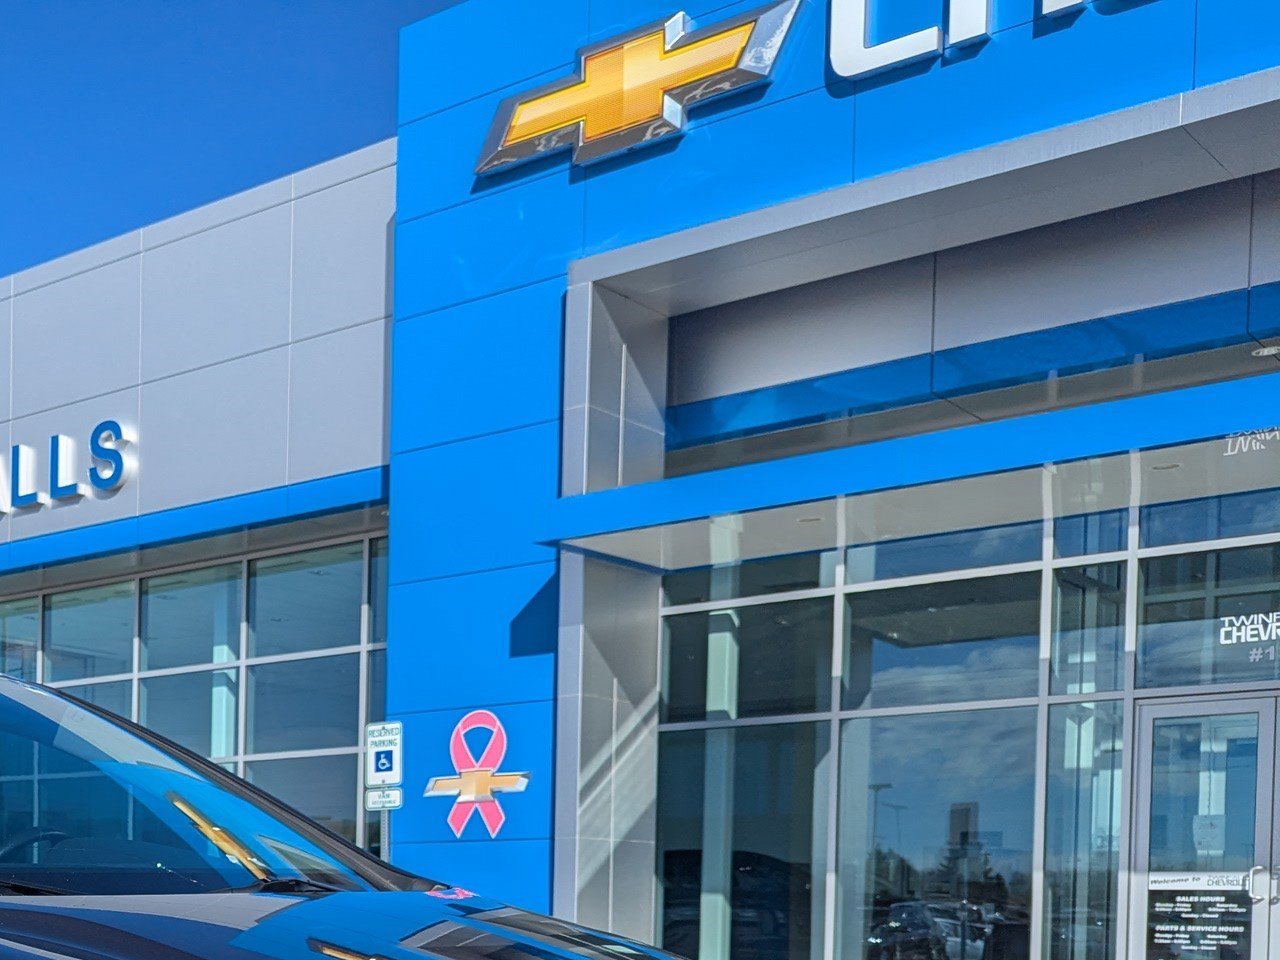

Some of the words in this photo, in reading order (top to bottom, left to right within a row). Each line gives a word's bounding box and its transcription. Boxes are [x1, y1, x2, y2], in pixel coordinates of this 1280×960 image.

[1249, 645, 1275, 662] #1
[368, 727, 400, 738] RESERVED
[370, 738, 398, 748] PARKING
[1150, 877, 1189, 885] Welcome
